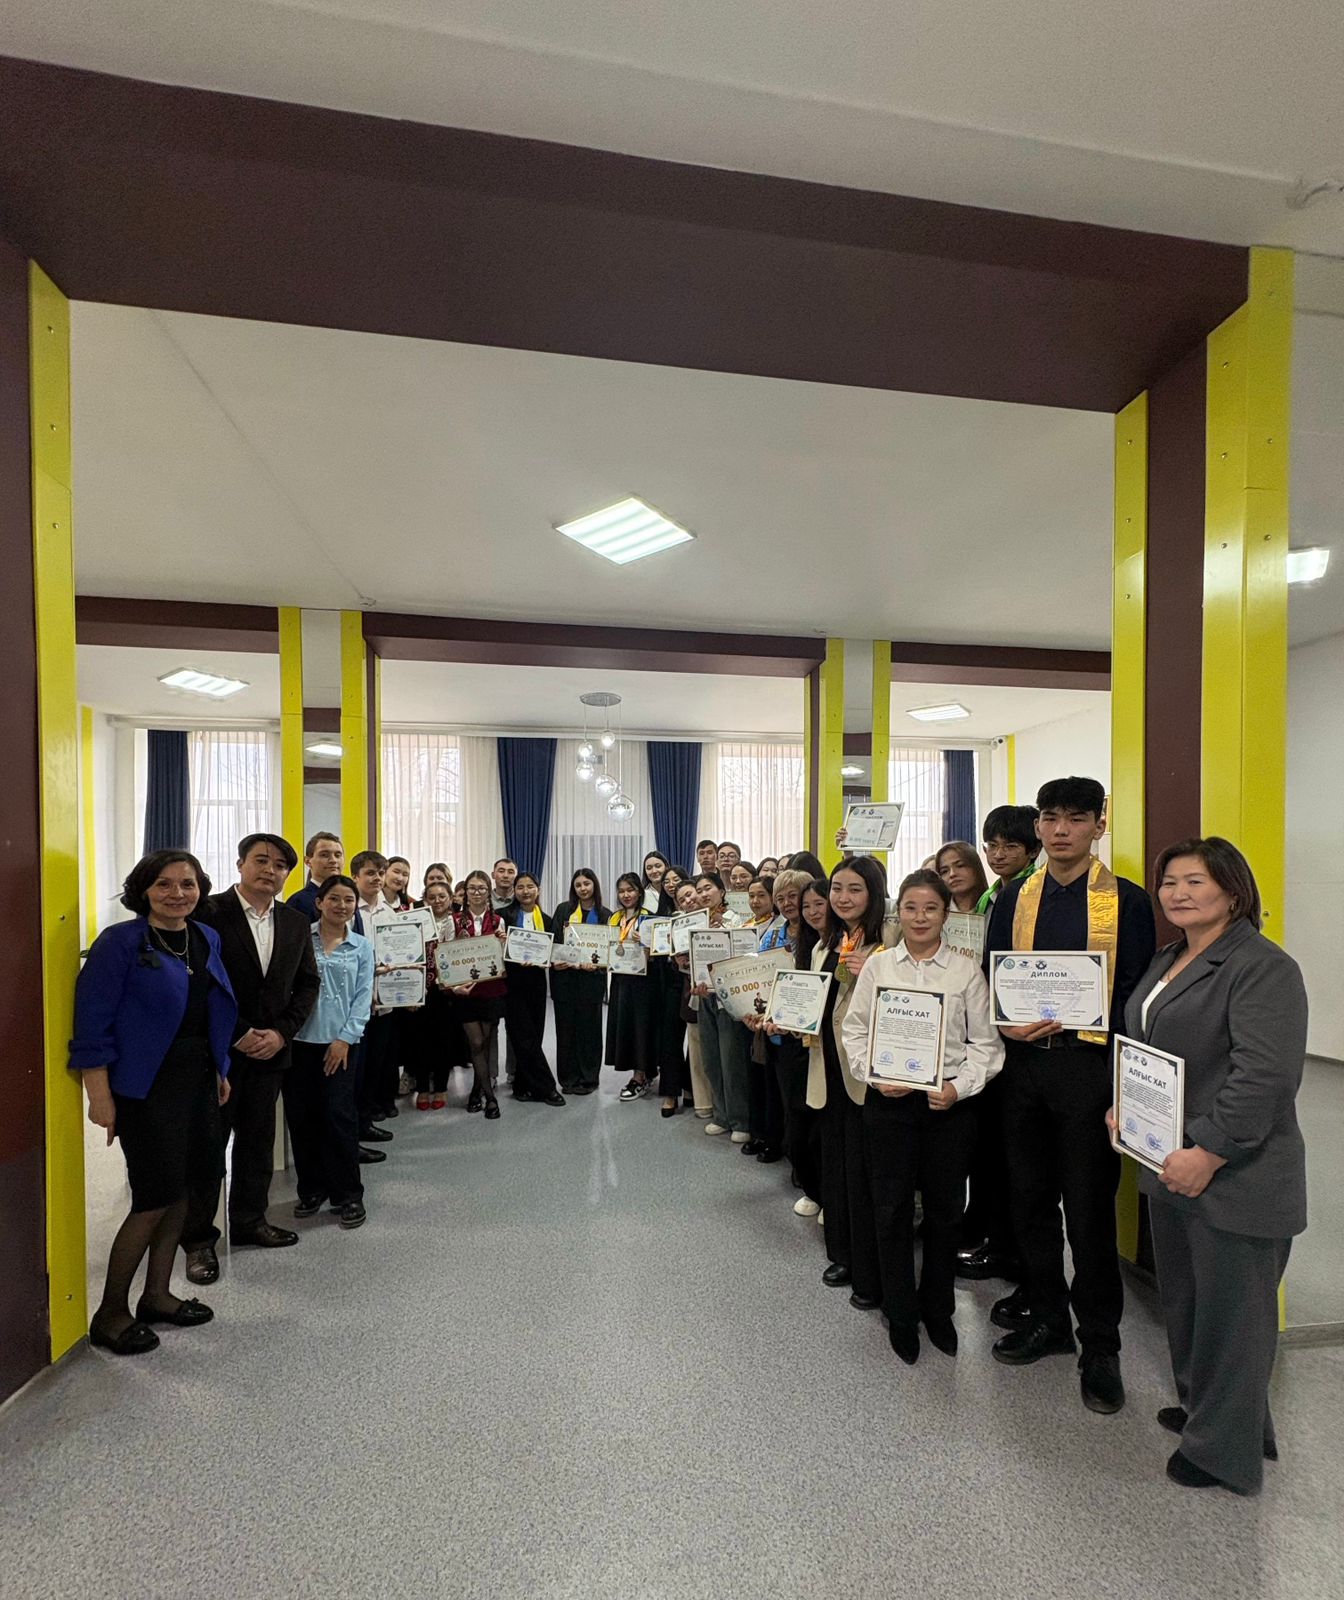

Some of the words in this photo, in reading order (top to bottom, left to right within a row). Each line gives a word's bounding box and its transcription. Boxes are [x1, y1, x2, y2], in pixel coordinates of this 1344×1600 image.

[461, 957, 476, 965] 000
[729, 985, 741, 996] 50
[741, 981, 760, 993] 000
[886, 1007, 914, 1017] АЛҒЫС
[914, 1010, 931, 1019] ХАТ
[1128, 1066, 1153, 1084] АЛҒЫС
[1152, 1077, 1167, 1090] ХАТ
